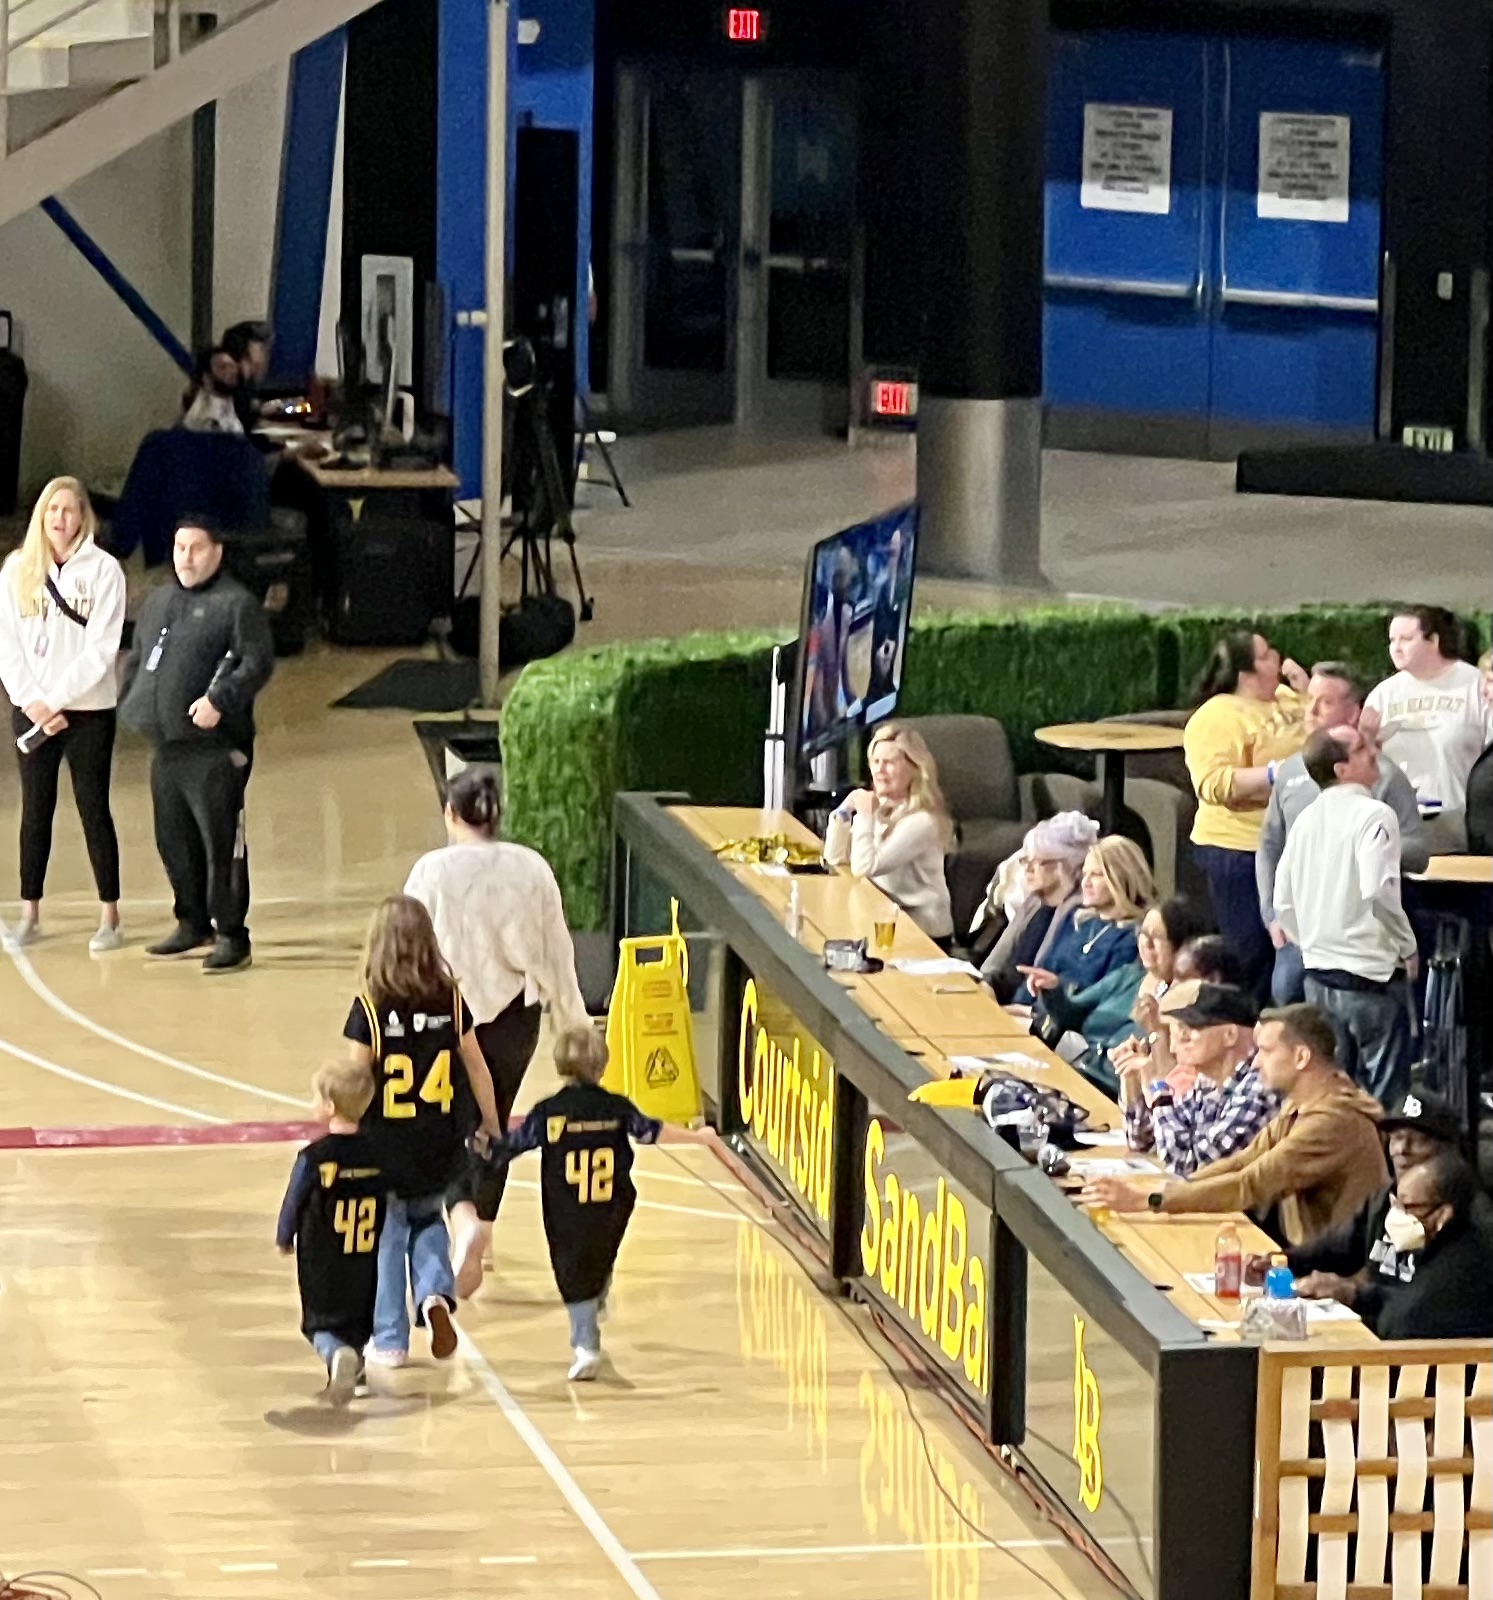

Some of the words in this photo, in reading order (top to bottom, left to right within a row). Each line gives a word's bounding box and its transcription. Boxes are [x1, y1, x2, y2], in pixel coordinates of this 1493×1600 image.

[729, 9, 759, 40] EXIT
[876, 383, 909, 414] EXIT
[383, 1049, 454, 1118] 24
[565, 1147, 615, 1204] 42
[334, 1197, 377, 1254] 42
